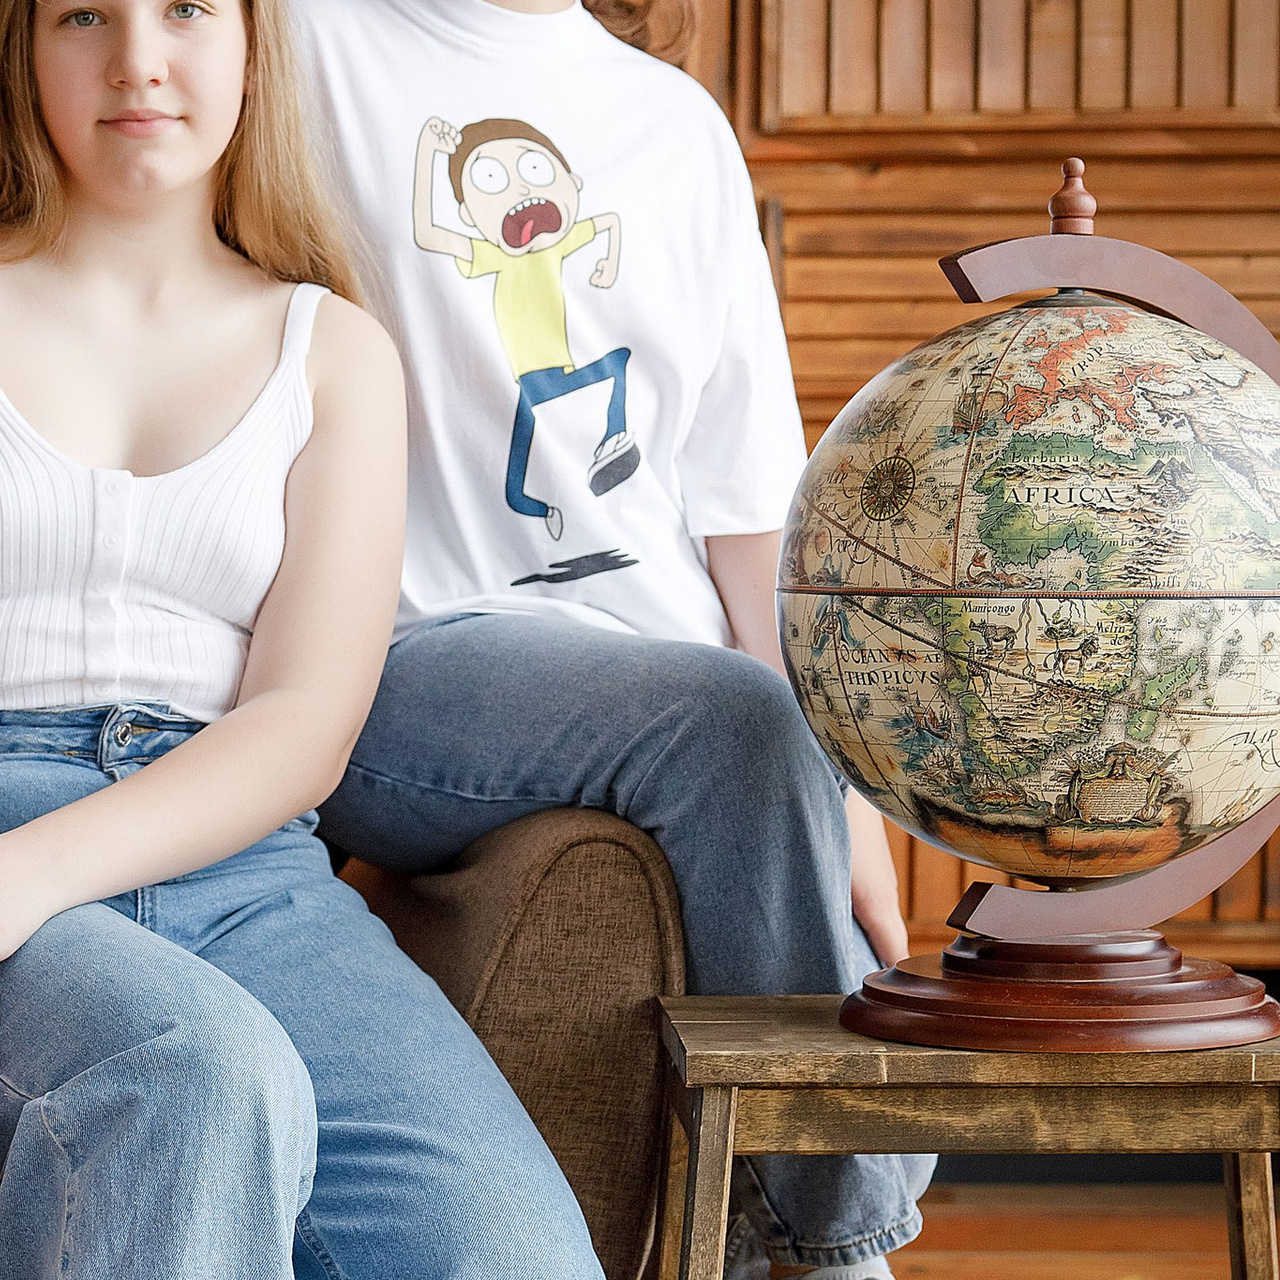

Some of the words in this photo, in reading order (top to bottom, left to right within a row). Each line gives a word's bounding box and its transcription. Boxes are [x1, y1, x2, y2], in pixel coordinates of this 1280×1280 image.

[1011, 451, 1079, 463] Barbaria
[1004, 487, 1116, 505] AFRICA
[959, 601, 1016, 617] Manicongo
[924, 650, 944, 664] AE
